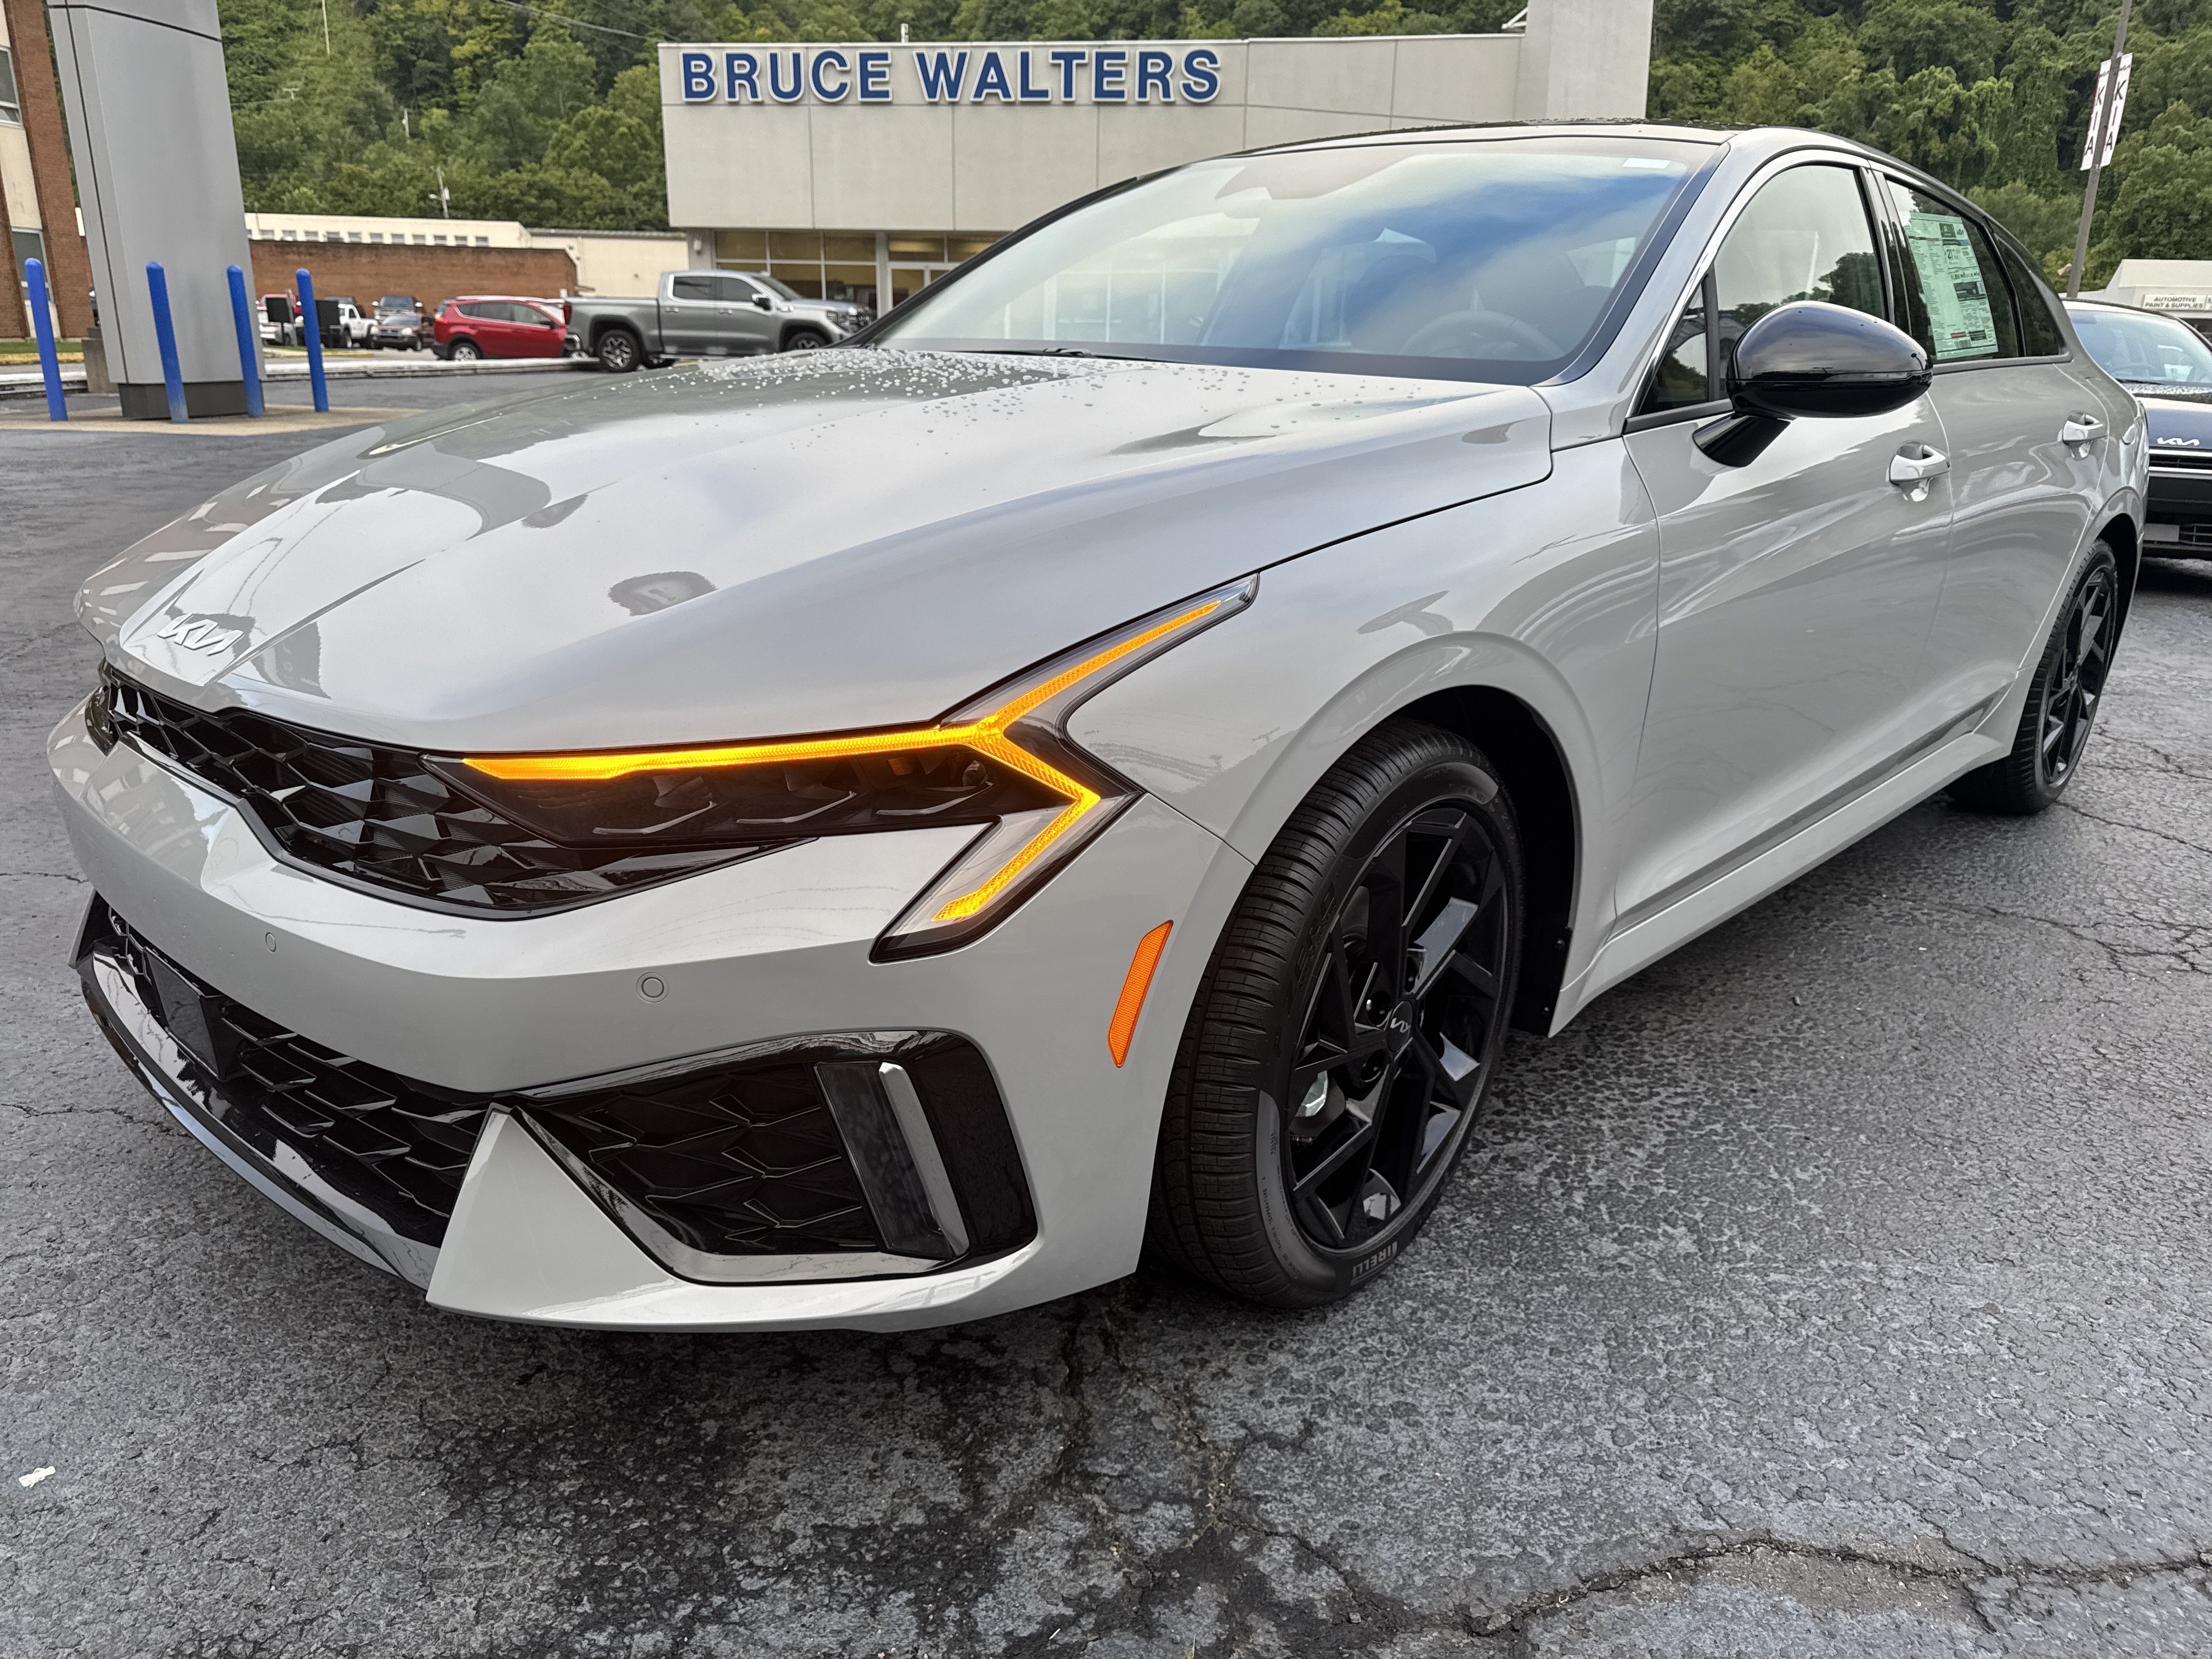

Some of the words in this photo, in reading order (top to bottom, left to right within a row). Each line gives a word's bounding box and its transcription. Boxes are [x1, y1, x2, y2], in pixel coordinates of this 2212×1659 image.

[680, 49, 892, 103] BRUCE
[913, 48, 1222, 103] WALTERS
[2085, 84, 2105, 156] KIA
[2105, 80, 2127, 151] KIA
[1351, 1241, 1398, 1284] PIRELLI
